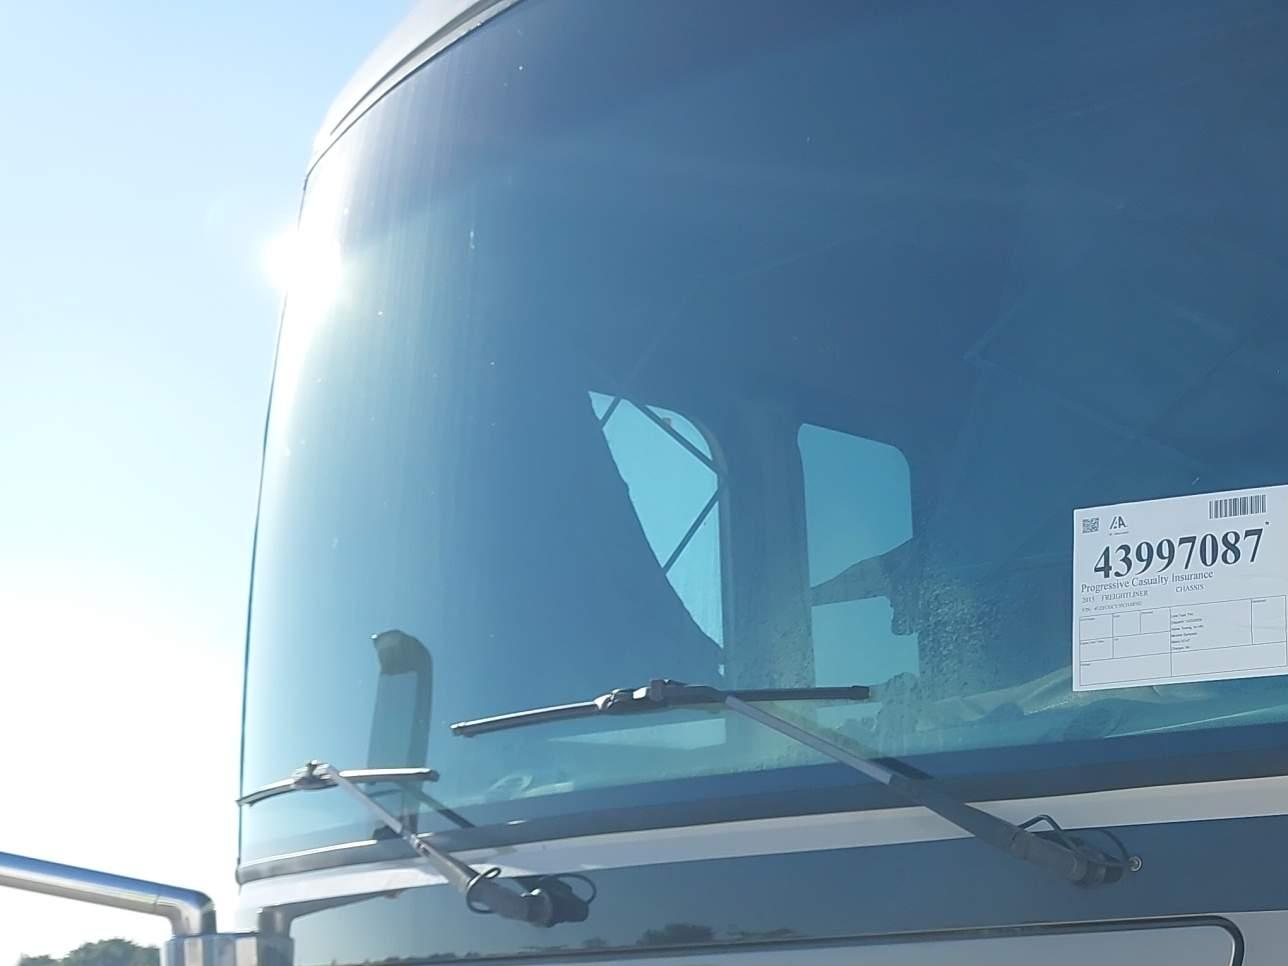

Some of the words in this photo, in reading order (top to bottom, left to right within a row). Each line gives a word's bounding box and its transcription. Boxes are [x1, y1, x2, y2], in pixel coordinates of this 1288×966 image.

[1093, 528, 1264, 579] 43997087
[1081, 580, 1130, 593] Progressive
[1132, 575, 1169, 587] Casualty
[1172, 570, 1214, 583] Insurance
[1176, 584, 1205, 593] CHASSIS
